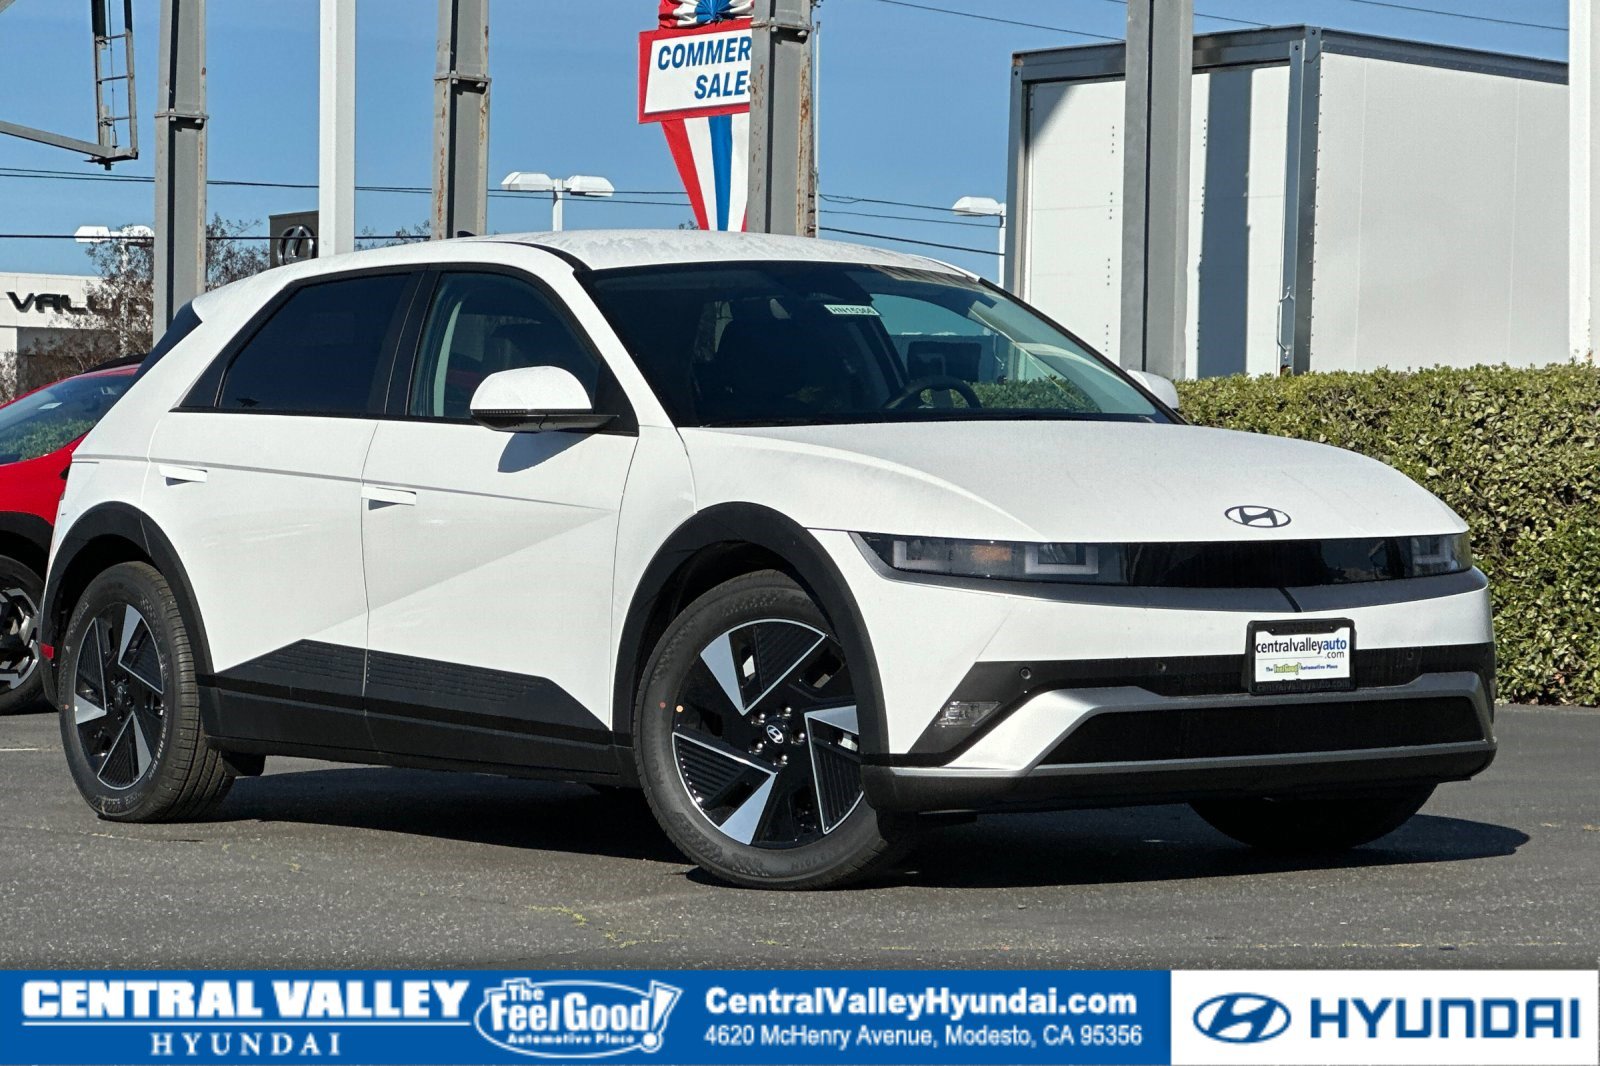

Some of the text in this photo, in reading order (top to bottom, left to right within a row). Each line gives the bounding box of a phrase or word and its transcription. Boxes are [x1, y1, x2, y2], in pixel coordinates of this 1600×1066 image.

[694, 70, 751, 100] SALE
[1255, 637, 1347, 655] centralvalleyauto
[1324, 650, 1345, 659] .com
